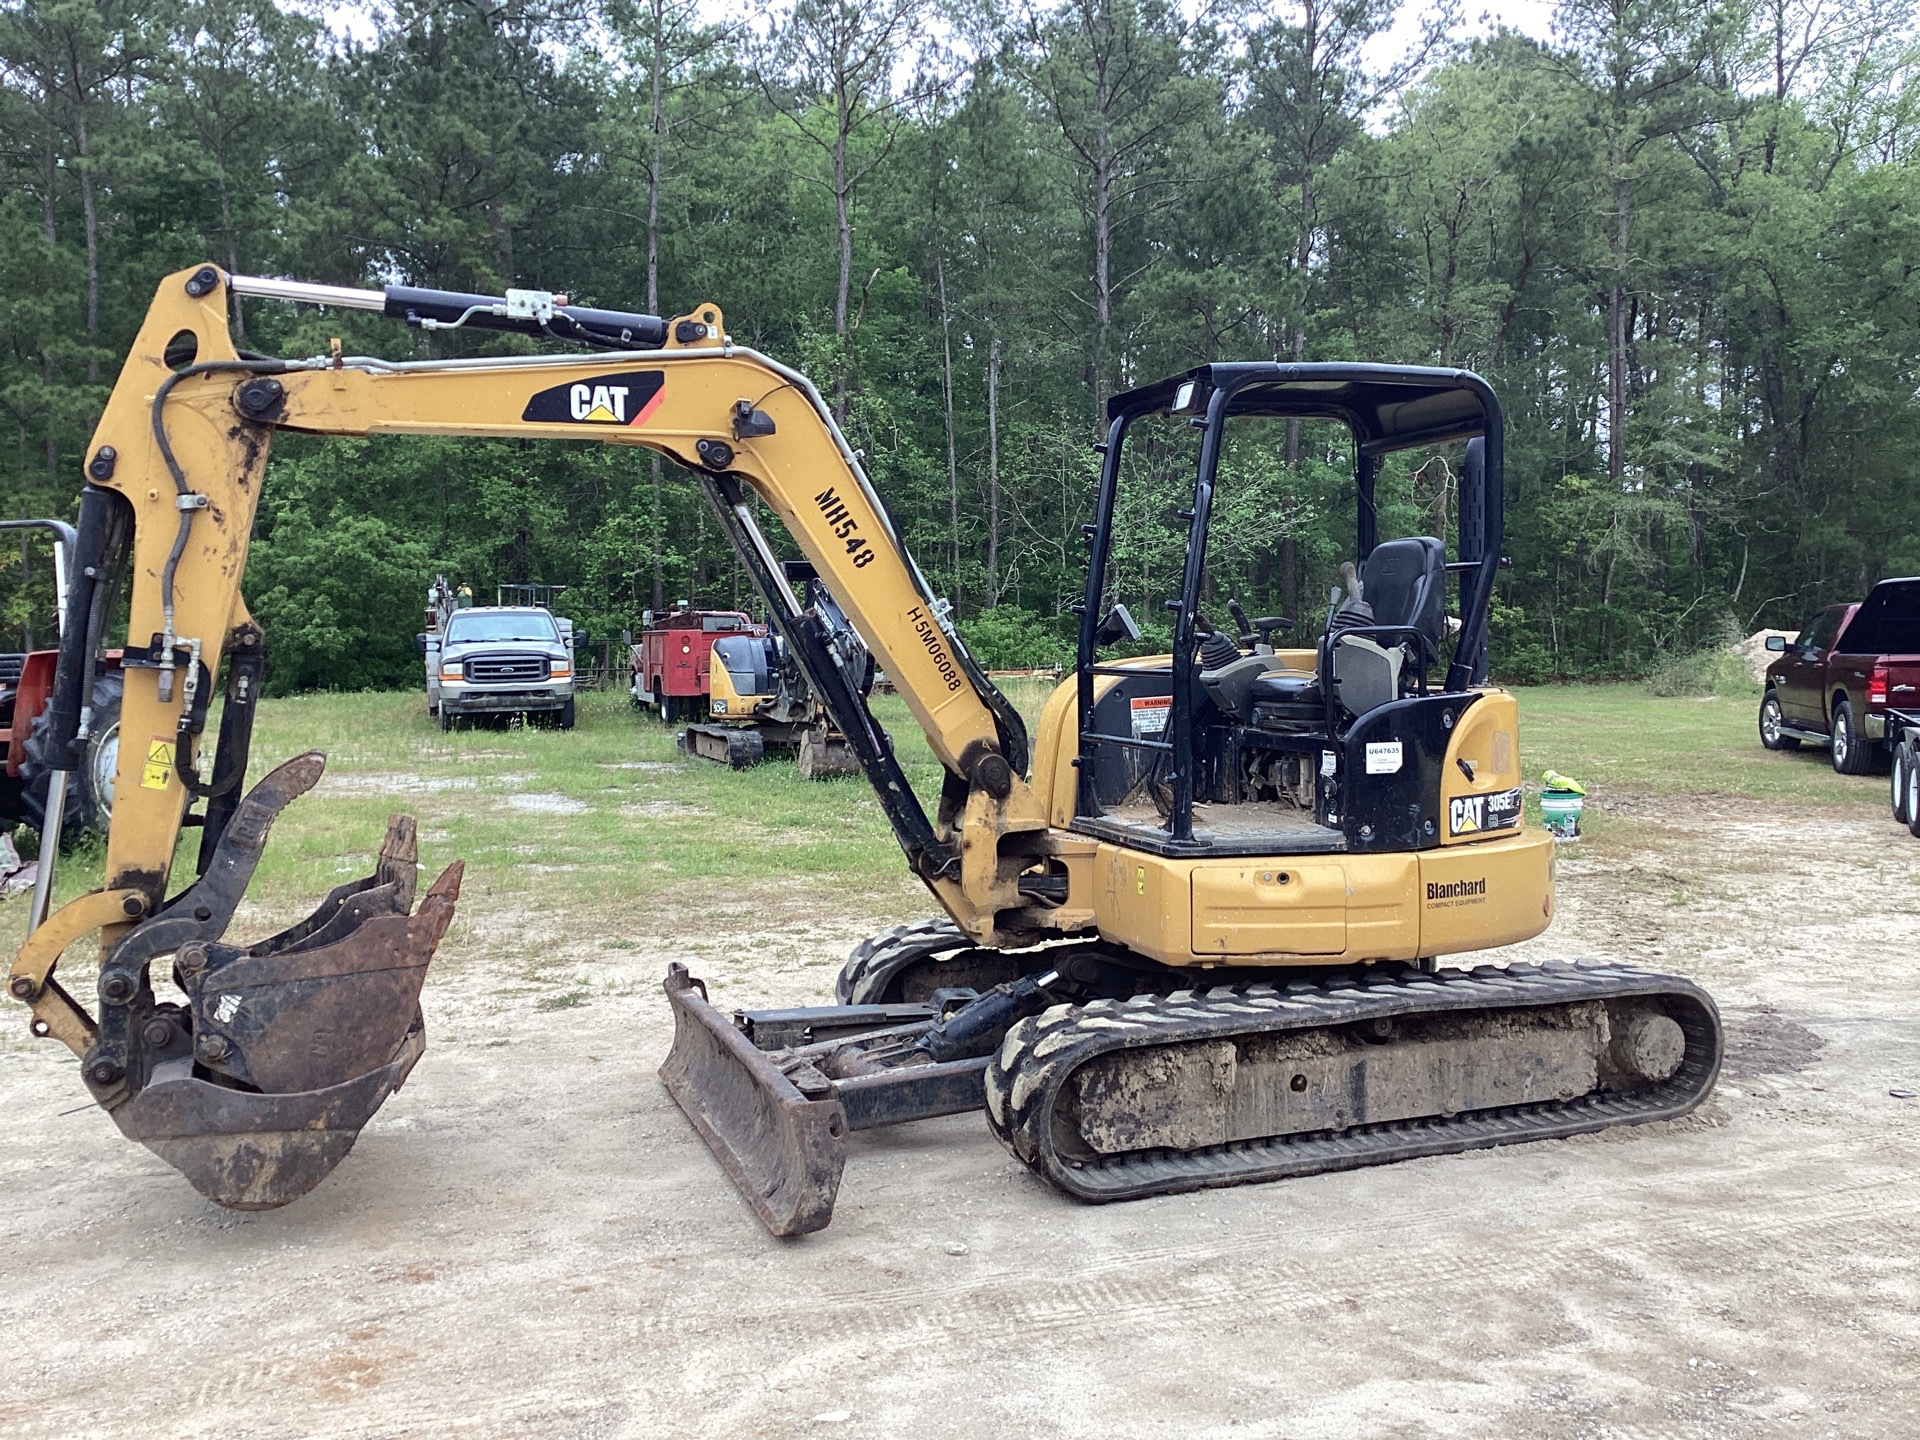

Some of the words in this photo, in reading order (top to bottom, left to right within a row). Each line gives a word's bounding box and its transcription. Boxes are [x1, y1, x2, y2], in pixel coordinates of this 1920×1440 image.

[570, 384, 629, 421] CAT
[814, 486, 875, 568] MH548
[907, 606, 962, 692] H5M06088
[1144, 699, 1172, 707] WARNING
[1369, 747, 1400, 755] U647635
[1451, 797, 1484, 833] CAT
[1427, 877, 1486, 900] Blanchard
[1427, 901, 1454, 910] COMPACT
[1455, 897, 1486, 907] EQUIPMENT
